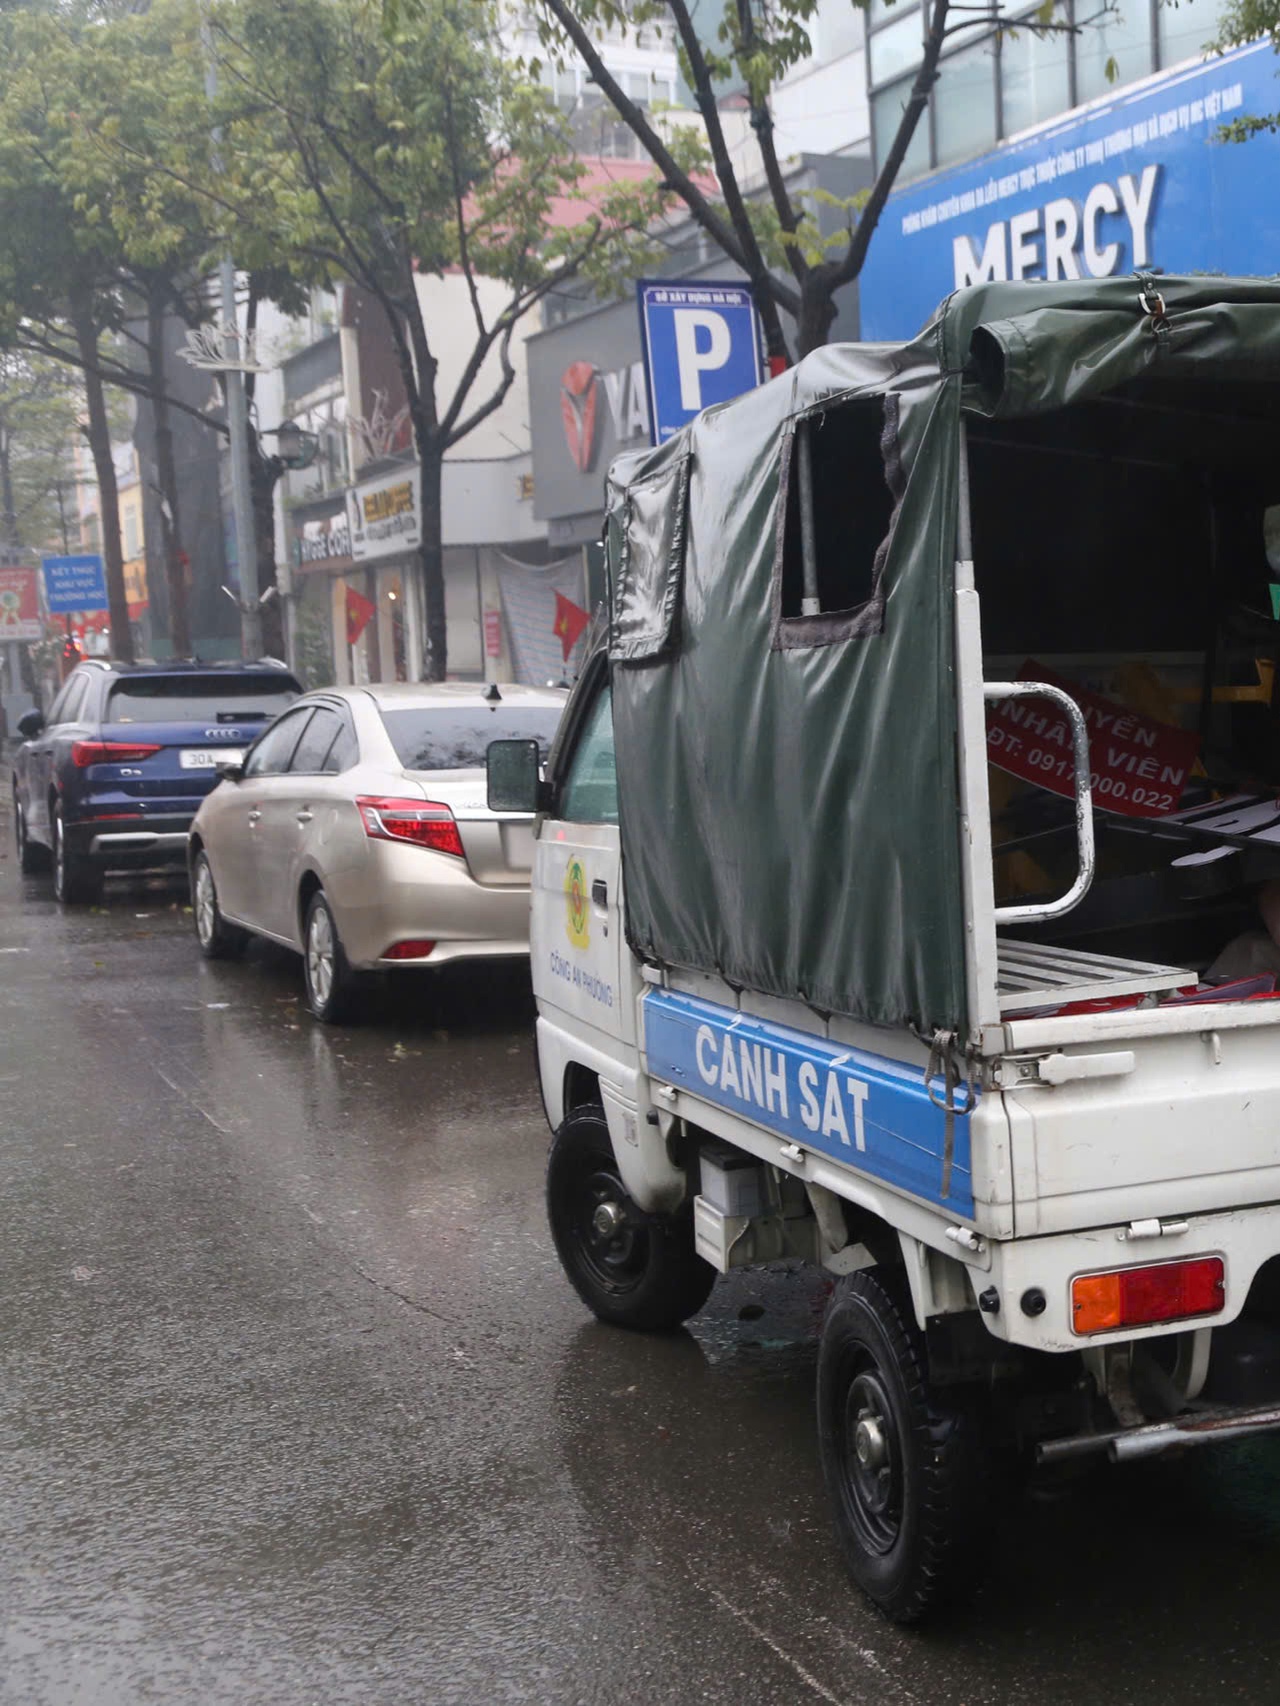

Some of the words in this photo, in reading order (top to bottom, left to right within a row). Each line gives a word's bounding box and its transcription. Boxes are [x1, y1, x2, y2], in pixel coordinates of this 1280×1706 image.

[953, 163, 1161, 289] MERCY
[674, 309, 731, 411] P
[987, 726, 1023, 757] ĐT:
[1106, 747, 1185, 786] VIÊN
[695, 1013, 789, 1120] CẢNH
[799, 1053, 868, 1152] SÁT
